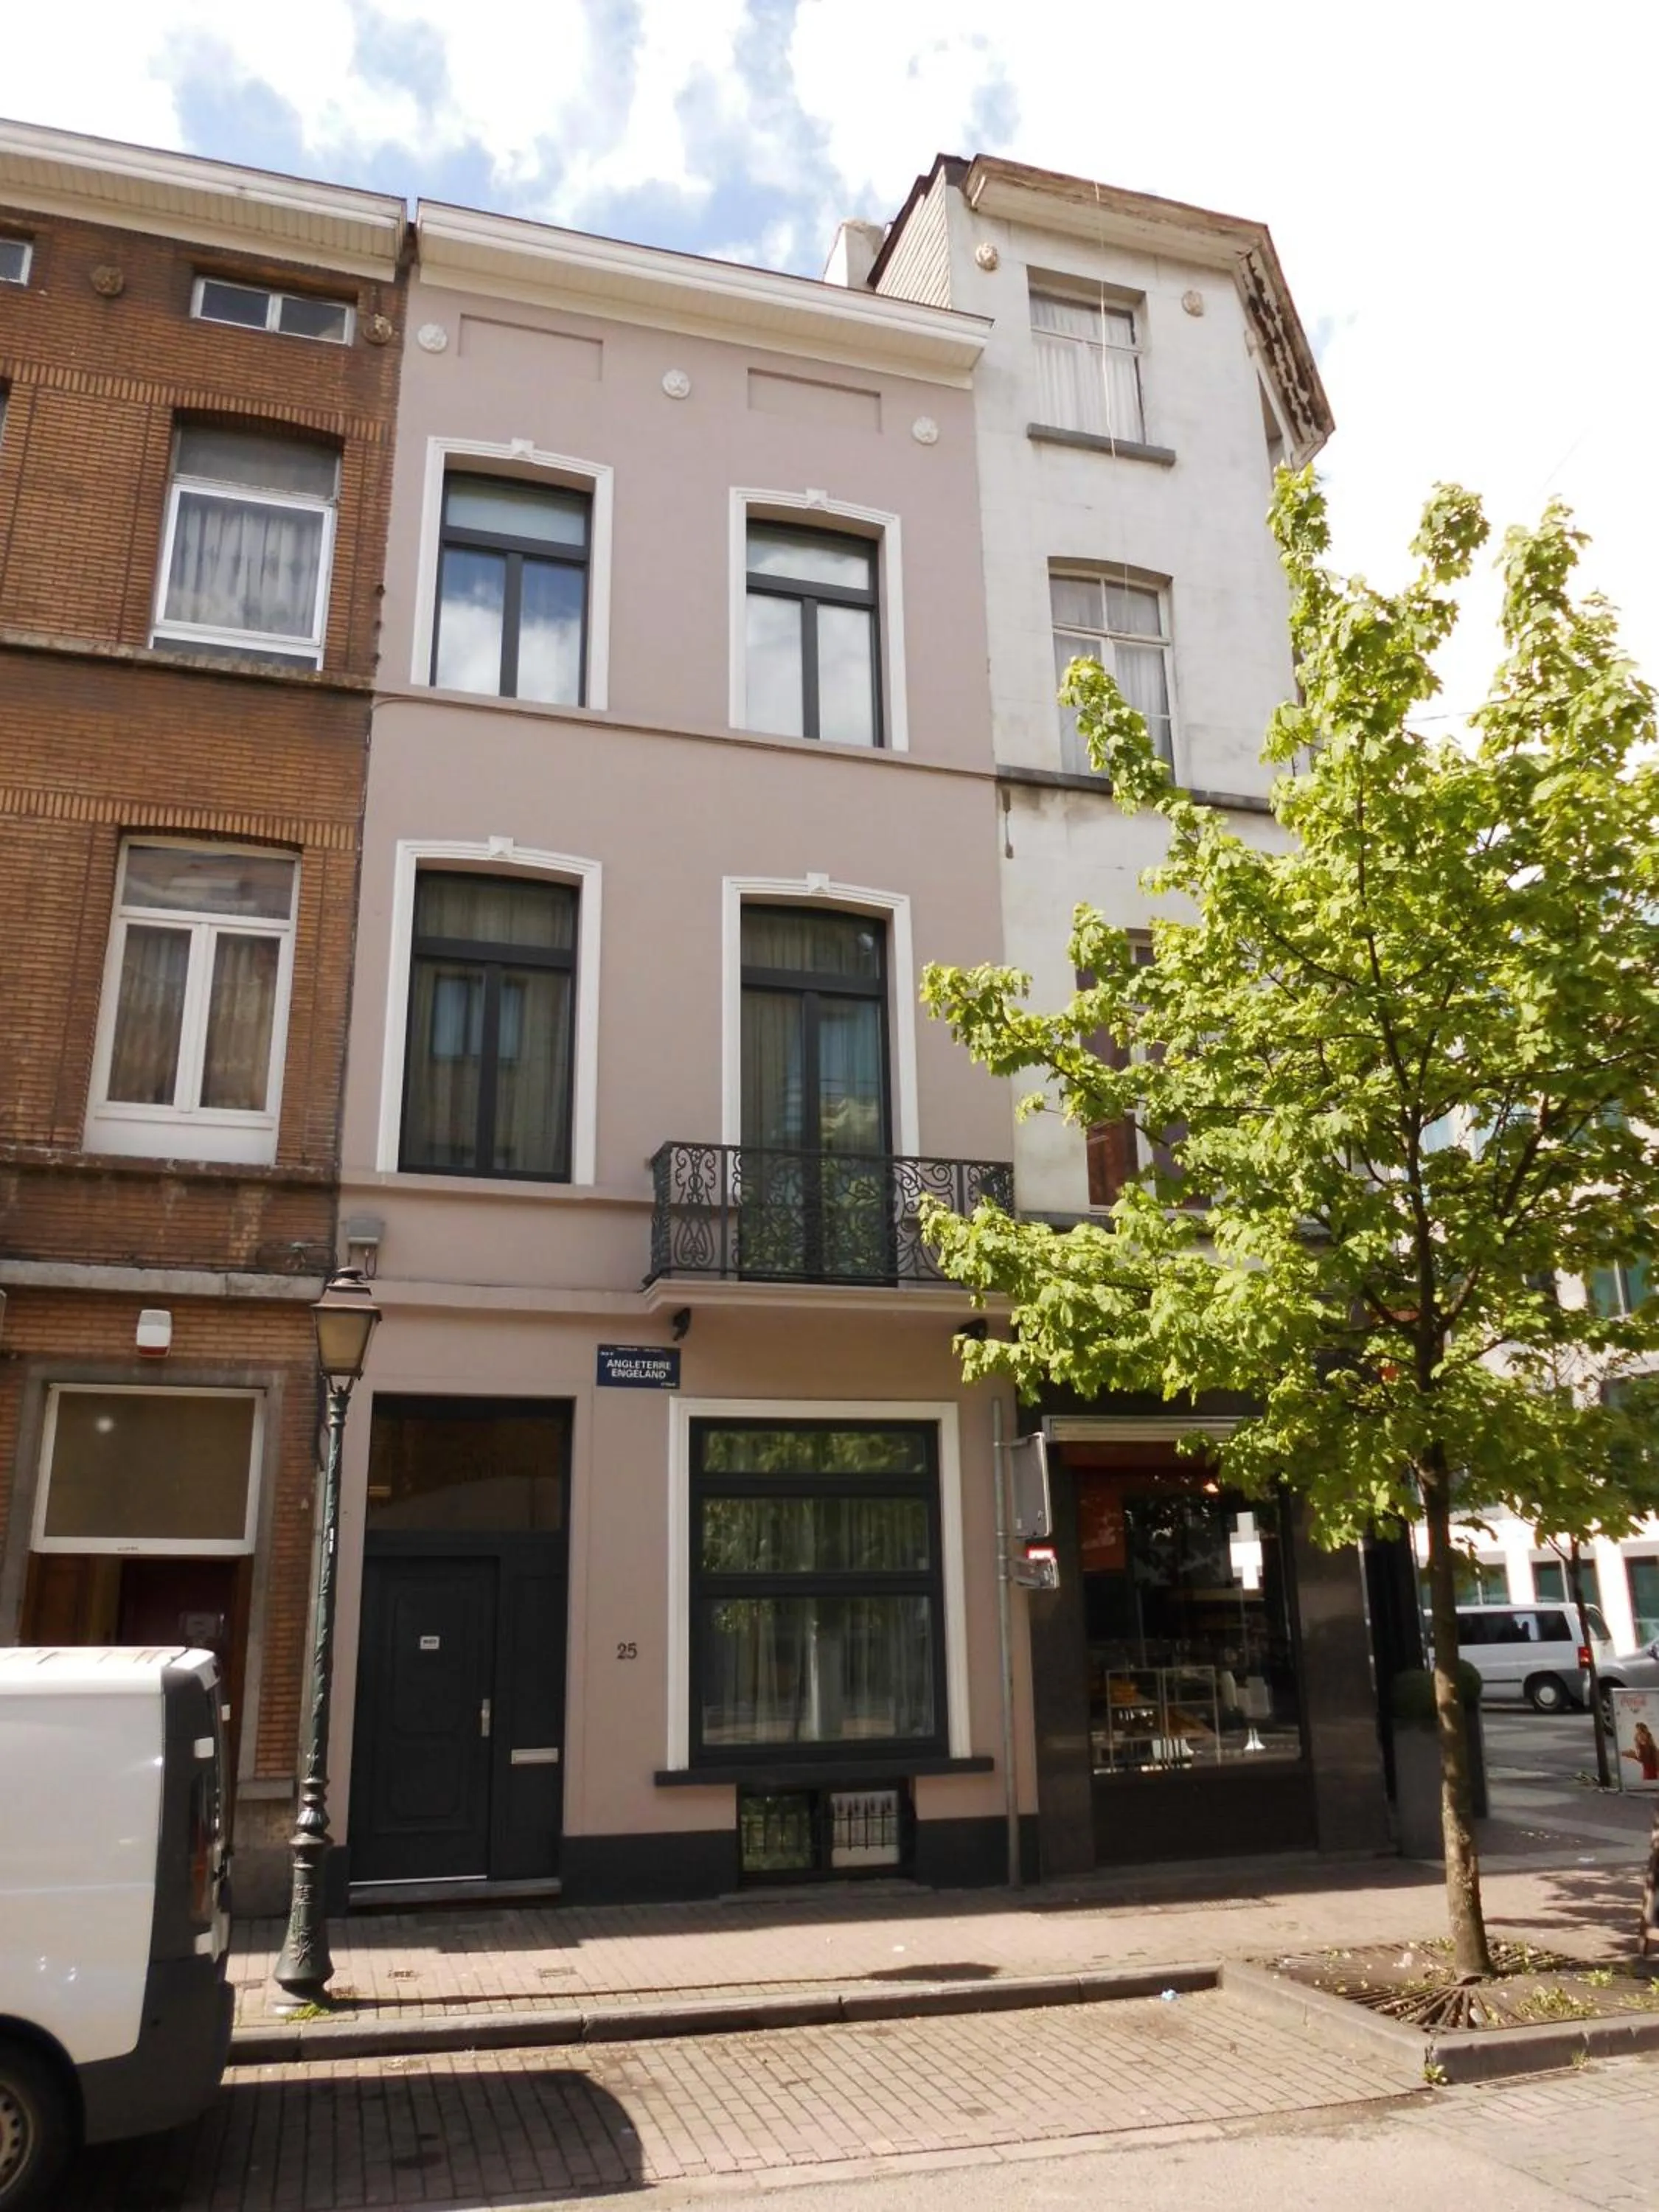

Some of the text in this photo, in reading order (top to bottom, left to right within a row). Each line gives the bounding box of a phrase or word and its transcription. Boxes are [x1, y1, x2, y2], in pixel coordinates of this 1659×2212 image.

[607, 1359, 672, 1370] ANGLETERRE
[611, 1368, 666, 1379] ENGELAND
[617, 1642, 638, 1659] 25
